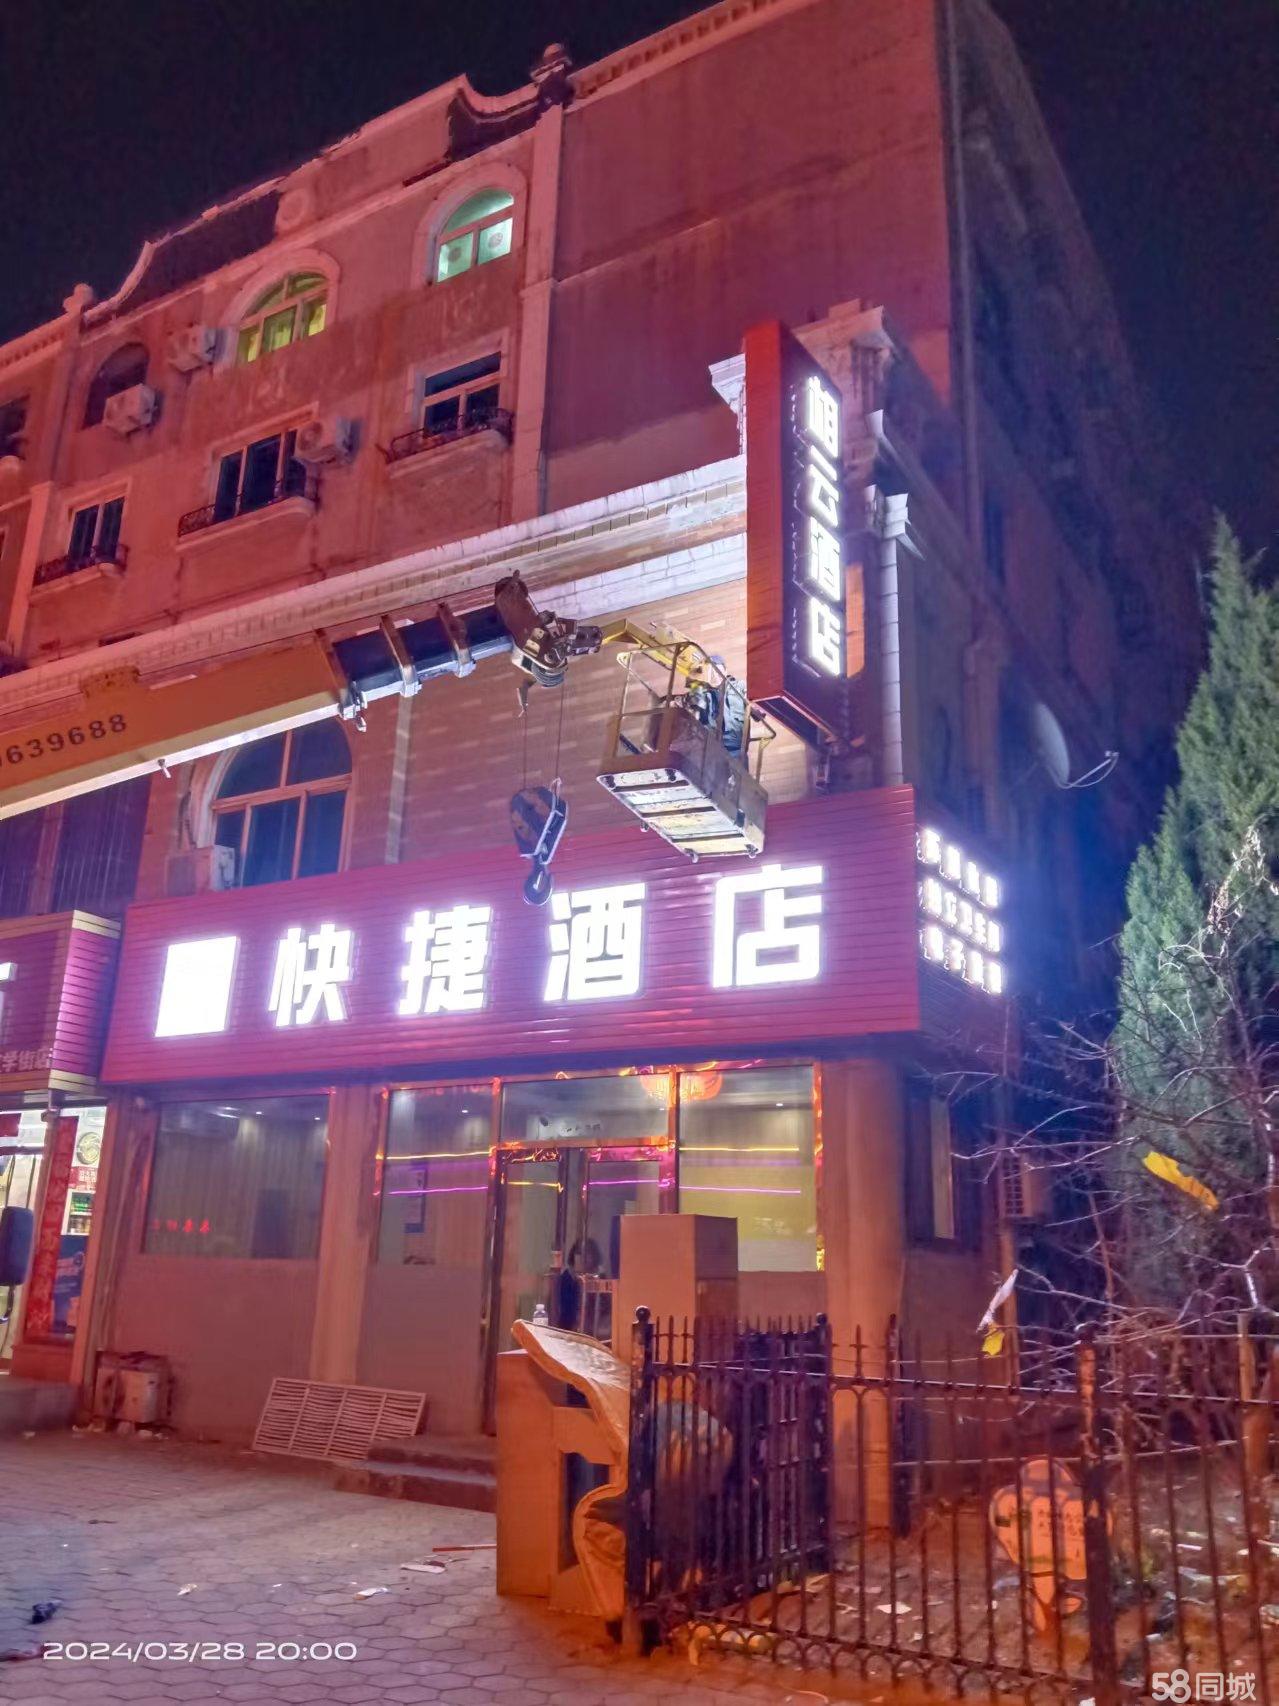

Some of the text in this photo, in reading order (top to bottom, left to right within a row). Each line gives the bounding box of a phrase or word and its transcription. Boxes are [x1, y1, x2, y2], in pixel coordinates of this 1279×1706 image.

[0, 714, 127, 767] 639688
[268, 863, 823, 1027] 快捷酒店
